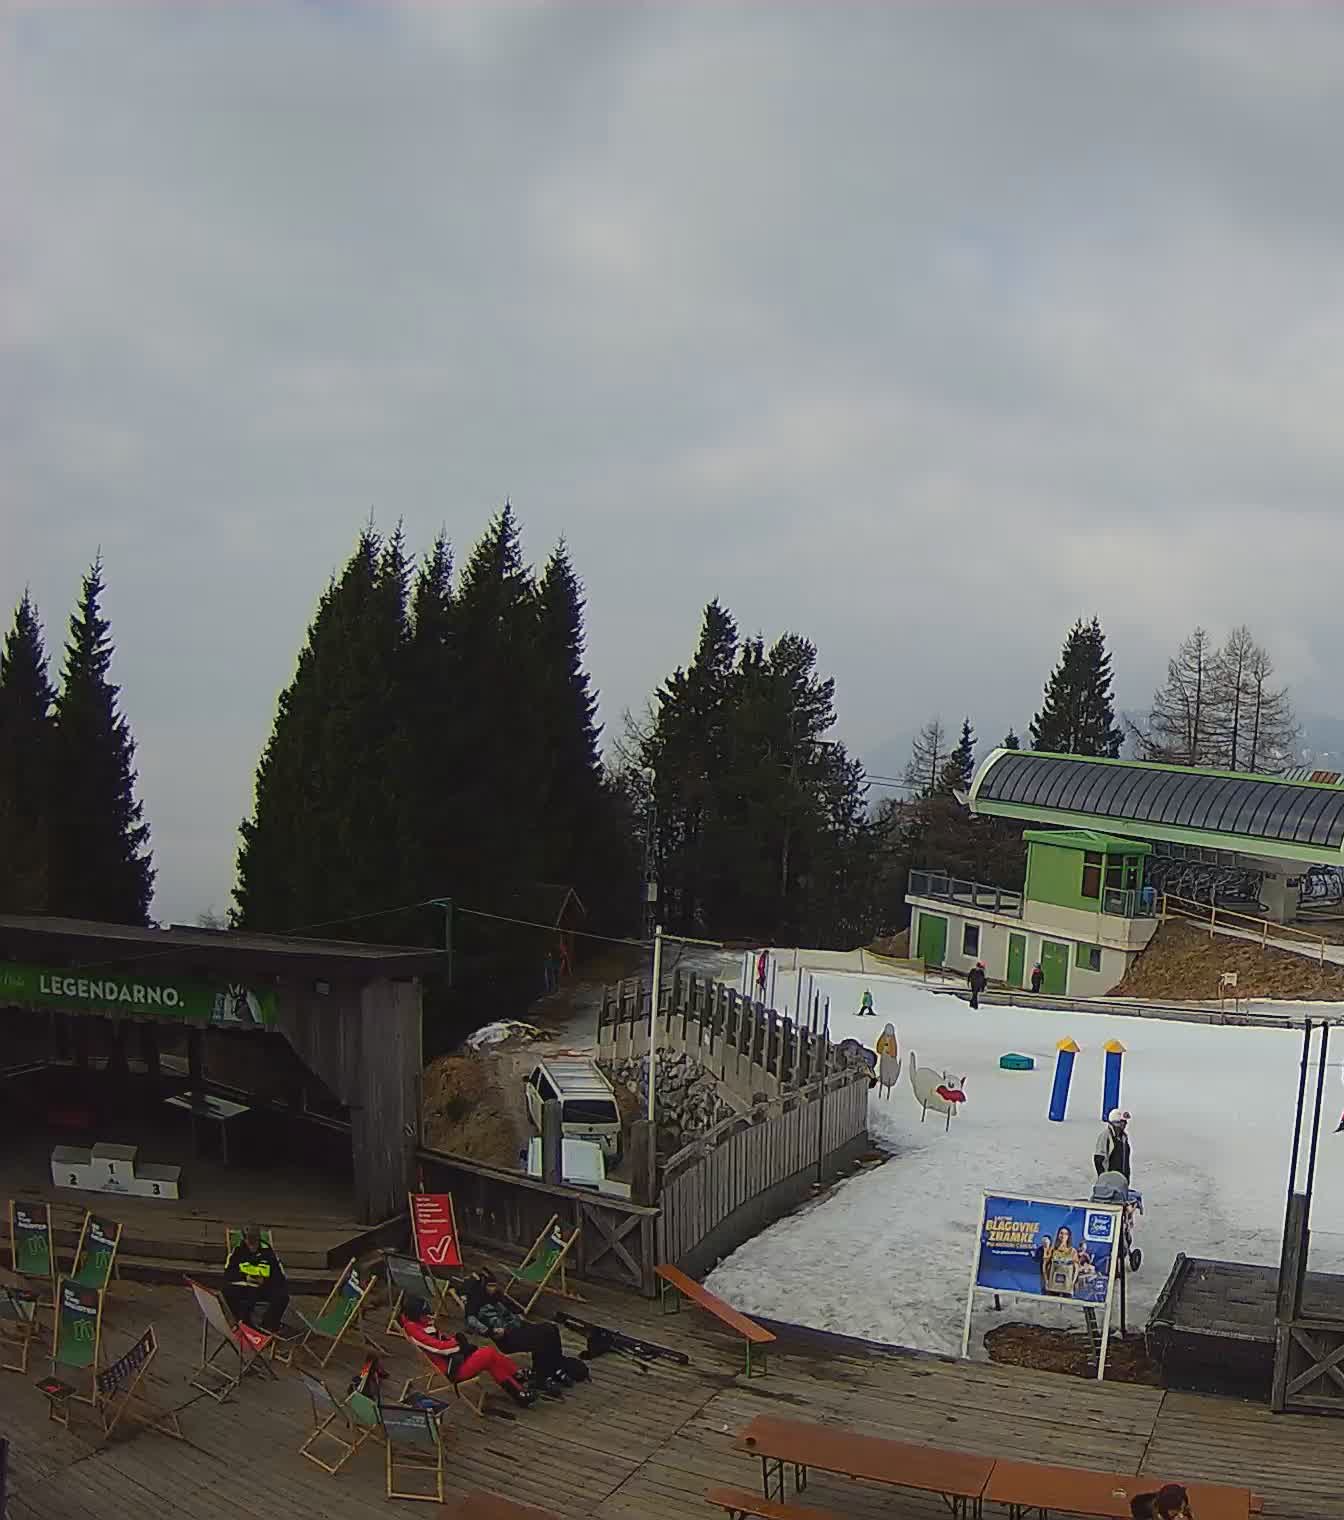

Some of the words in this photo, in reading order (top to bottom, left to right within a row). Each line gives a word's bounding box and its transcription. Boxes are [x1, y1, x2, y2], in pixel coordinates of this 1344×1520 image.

[39, 974, 185, 1008] LEGENDARNO.
[108, 1162, 116, 1175] 1
[69, 1173, 78, 1186] 2
[152, 1183, 161, 1196] 3
[986, 1219, 1041, 1234] BLAGOVNE
